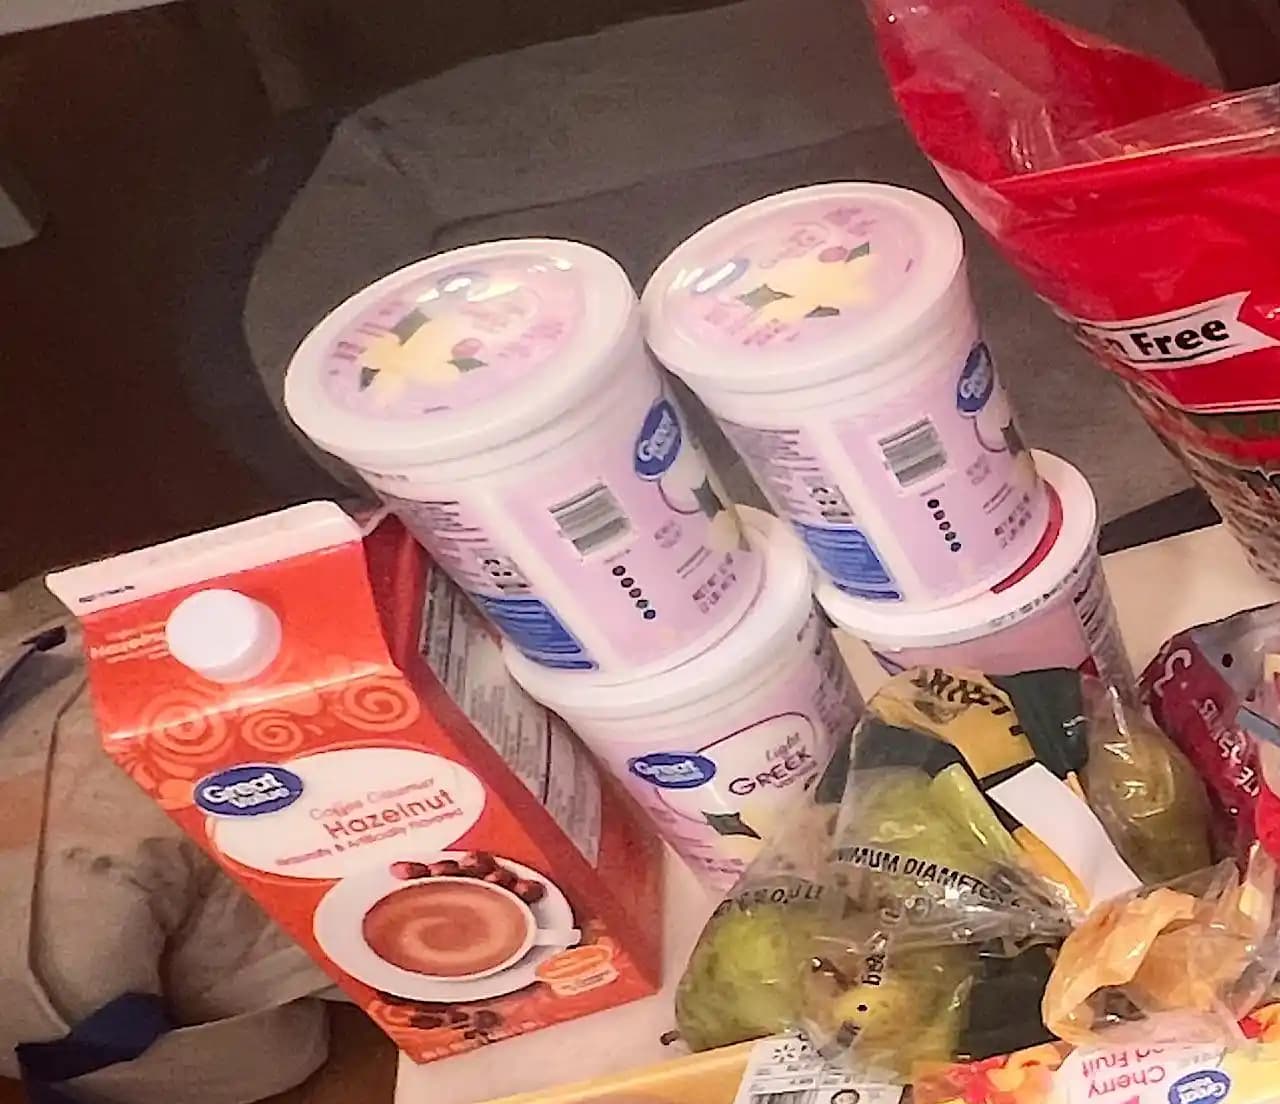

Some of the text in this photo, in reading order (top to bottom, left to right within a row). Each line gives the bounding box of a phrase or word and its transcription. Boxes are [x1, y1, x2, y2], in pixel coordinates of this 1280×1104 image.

[1130, 317, 1231, 356] Free
[728, 750, 812, 796] GREEK
[322, 789, 456, 840] Hazelnut
[1087, 1064, 1166, 1099] Cherry
